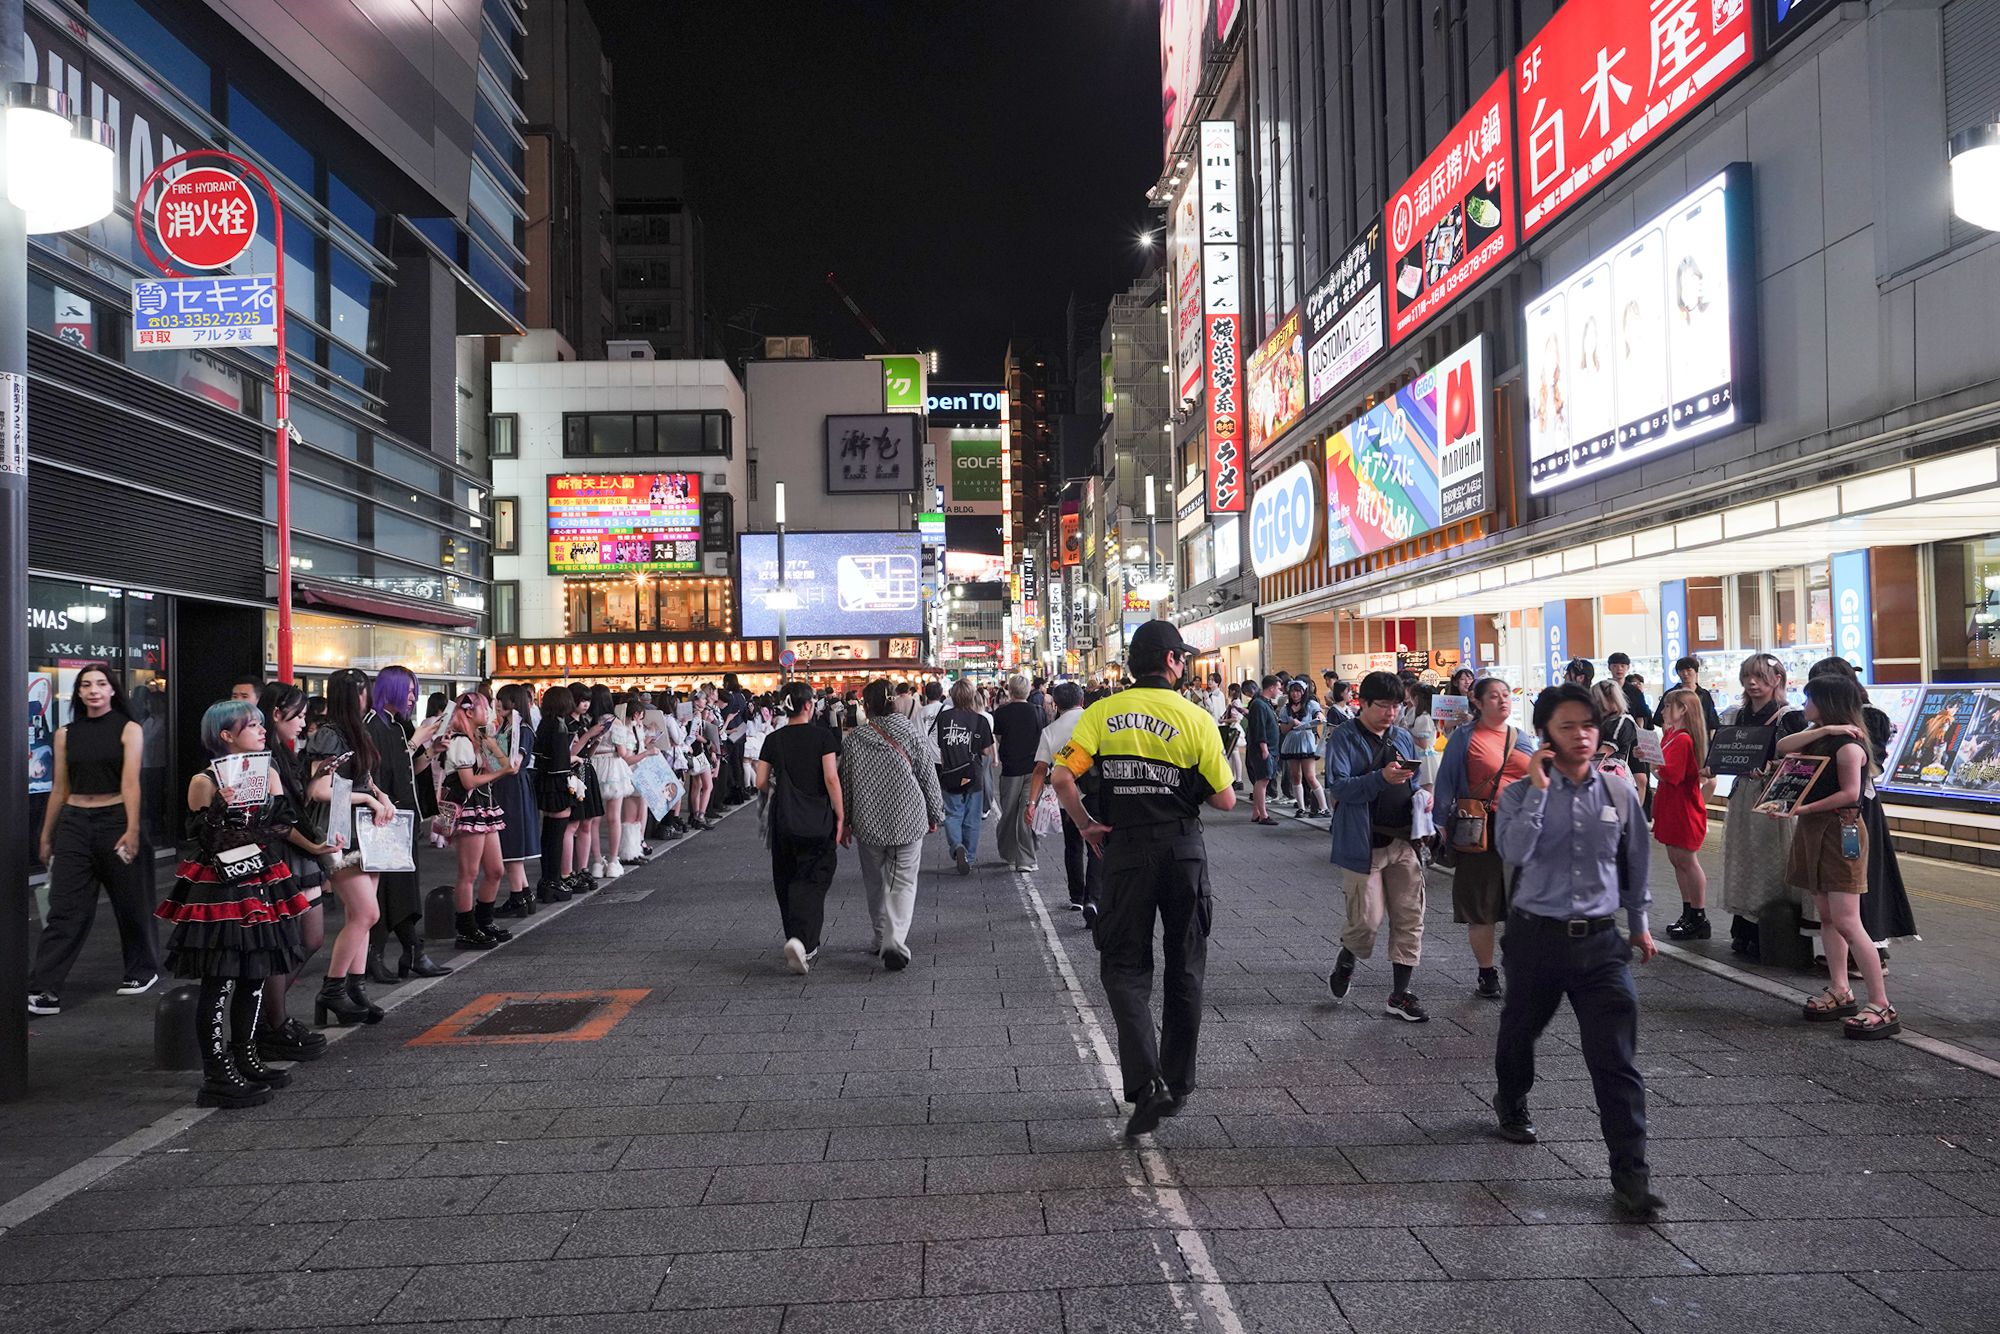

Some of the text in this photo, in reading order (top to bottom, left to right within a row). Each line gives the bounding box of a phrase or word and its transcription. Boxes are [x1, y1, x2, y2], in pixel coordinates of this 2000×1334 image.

[1522, 45, 1542, 95] 5F
[1529, 0, 1707, 198] 白木屋
[1414, 103, 1501, 227] 海底撈火鍋
[1485, 158, 1505, 193] 6F
[172, 180, 237, 195] FIRE HYDRANT
[166, 197, 248, 239] 消火栓
[1367, 224, 1379, 256] 7F
[1306, 241, 1367, 320] インターネットカフェ
[1446, 234, 1504, 292] 03-6278-9799
[171, 278, 274, 314] セキネ
[139, 327, 253, 344] 買取 アルタ裏
[160, 311, 261, 328] 03-3352-7325
[1312, 295, 1377, 377] CUSTOMA CAFE
[1211, 317, 1237, 414] 横浜家系
[927, 393, 1001, 414] pen TO
[1355, 406, 1407, 452] ゲームの
[1214, 440, 1239, 510] ラーメン
[1361, 449, 1415, 487] オアシスに
[1441, 437, 1482, 478] MARUHAN
[556, 478, 635, 490] 新宿天上人間
[604, 517, 697, 527] 03-6205-5612
[1252, 476, 1311, 564] GiGO
[763, 560, 809, 570] カオケ
[1106, 712, 1180, 744] SECURITY
[1102, 760, 1144, 780] SAFETY
[1721, 755, 1750, 765] ¥2,000
